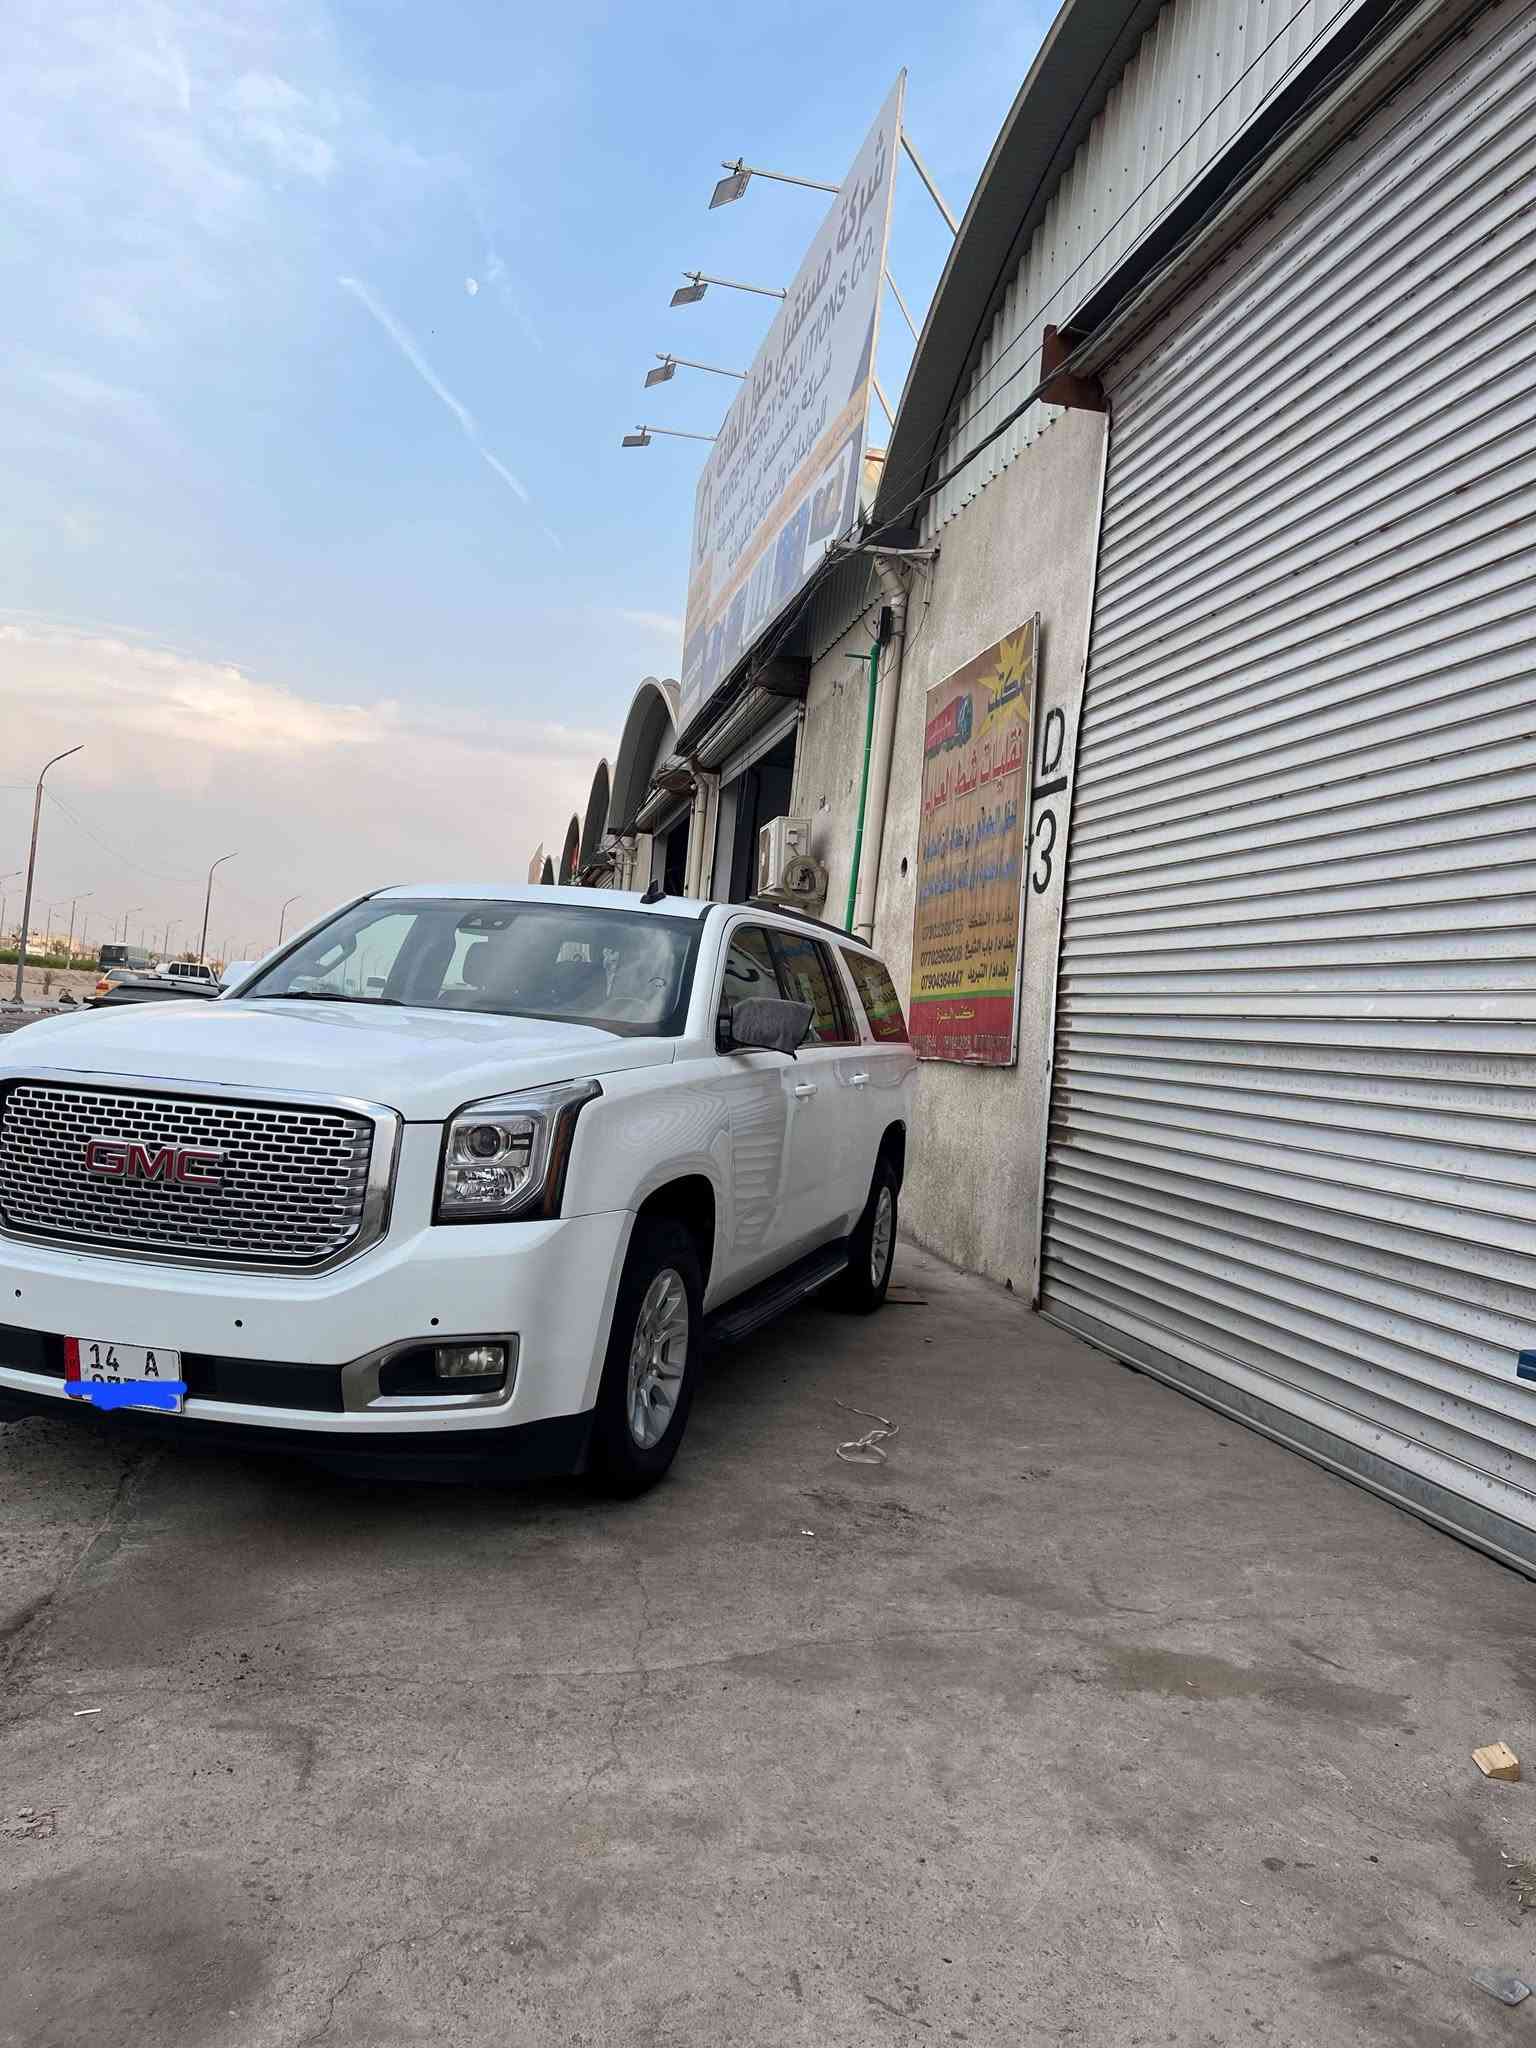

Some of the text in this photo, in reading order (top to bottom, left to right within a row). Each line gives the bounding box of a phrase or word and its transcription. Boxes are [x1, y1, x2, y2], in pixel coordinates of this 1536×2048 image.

[836, 129, 886, 253] شركة
[777, 271, 847, 411] SOLUTIONS
[850, 225, 874, 290] CO.
[987, 665, 1024, 719] مكتب
[1041, 708, 1065, 776] D
[1033, 809, 1056, 894] 3
[84, 1139, 228, 1188] GMC
[89, 1343, 159, 1377] 14 A
